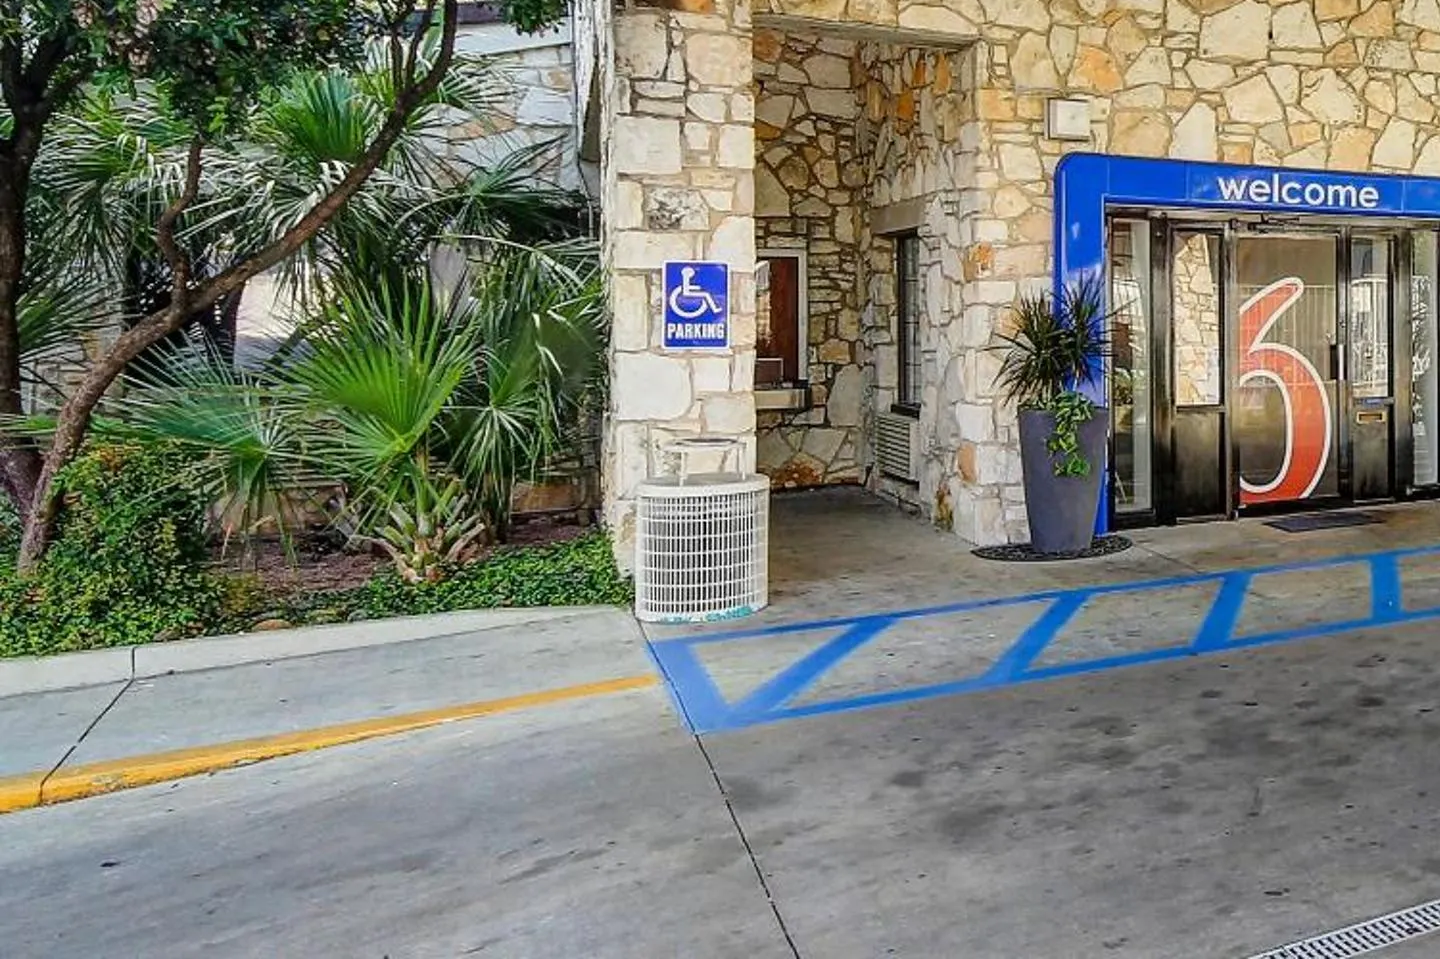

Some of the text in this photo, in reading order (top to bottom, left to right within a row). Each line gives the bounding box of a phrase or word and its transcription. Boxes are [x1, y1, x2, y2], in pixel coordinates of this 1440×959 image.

[1217, 173, 1379, 207] welcome
[667, 323, 724, 339] PARKING
[1239, 277, 1331, 506] 6
